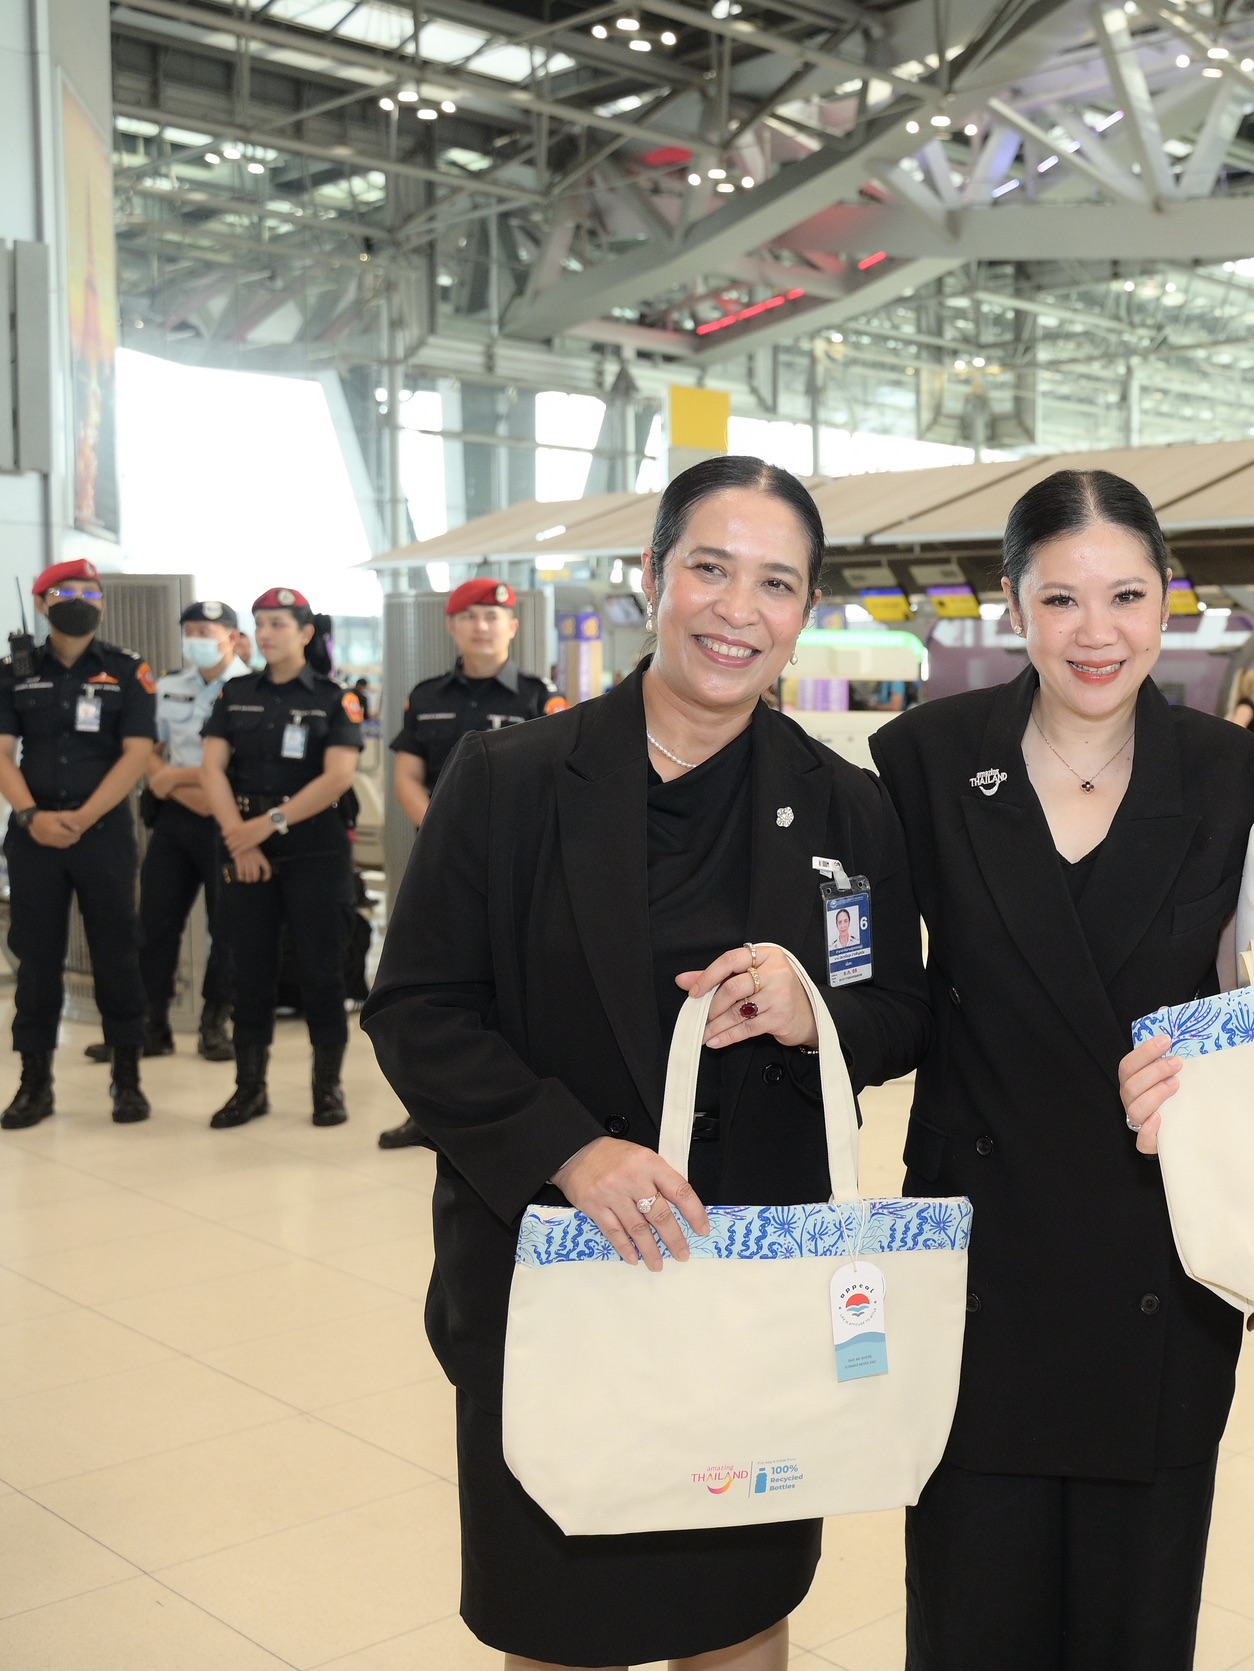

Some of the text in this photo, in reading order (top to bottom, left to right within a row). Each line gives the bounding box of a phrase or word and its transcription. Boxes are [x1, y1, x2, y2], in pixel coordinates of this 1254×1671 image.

[969, 771, 1008, 787] THAILAND
[860, 916, 868, 930] 6
[840, 1283, 875, 1299] appeal
[706, 1464, 734, 1472] amazing
[770, 1464, 799, 1475] 100%
[691, 1470, 749, 1483] THAILAND
[770, 1474, 804, 1484] Recycled
[769, 1483, 796, 1492] Bottles
